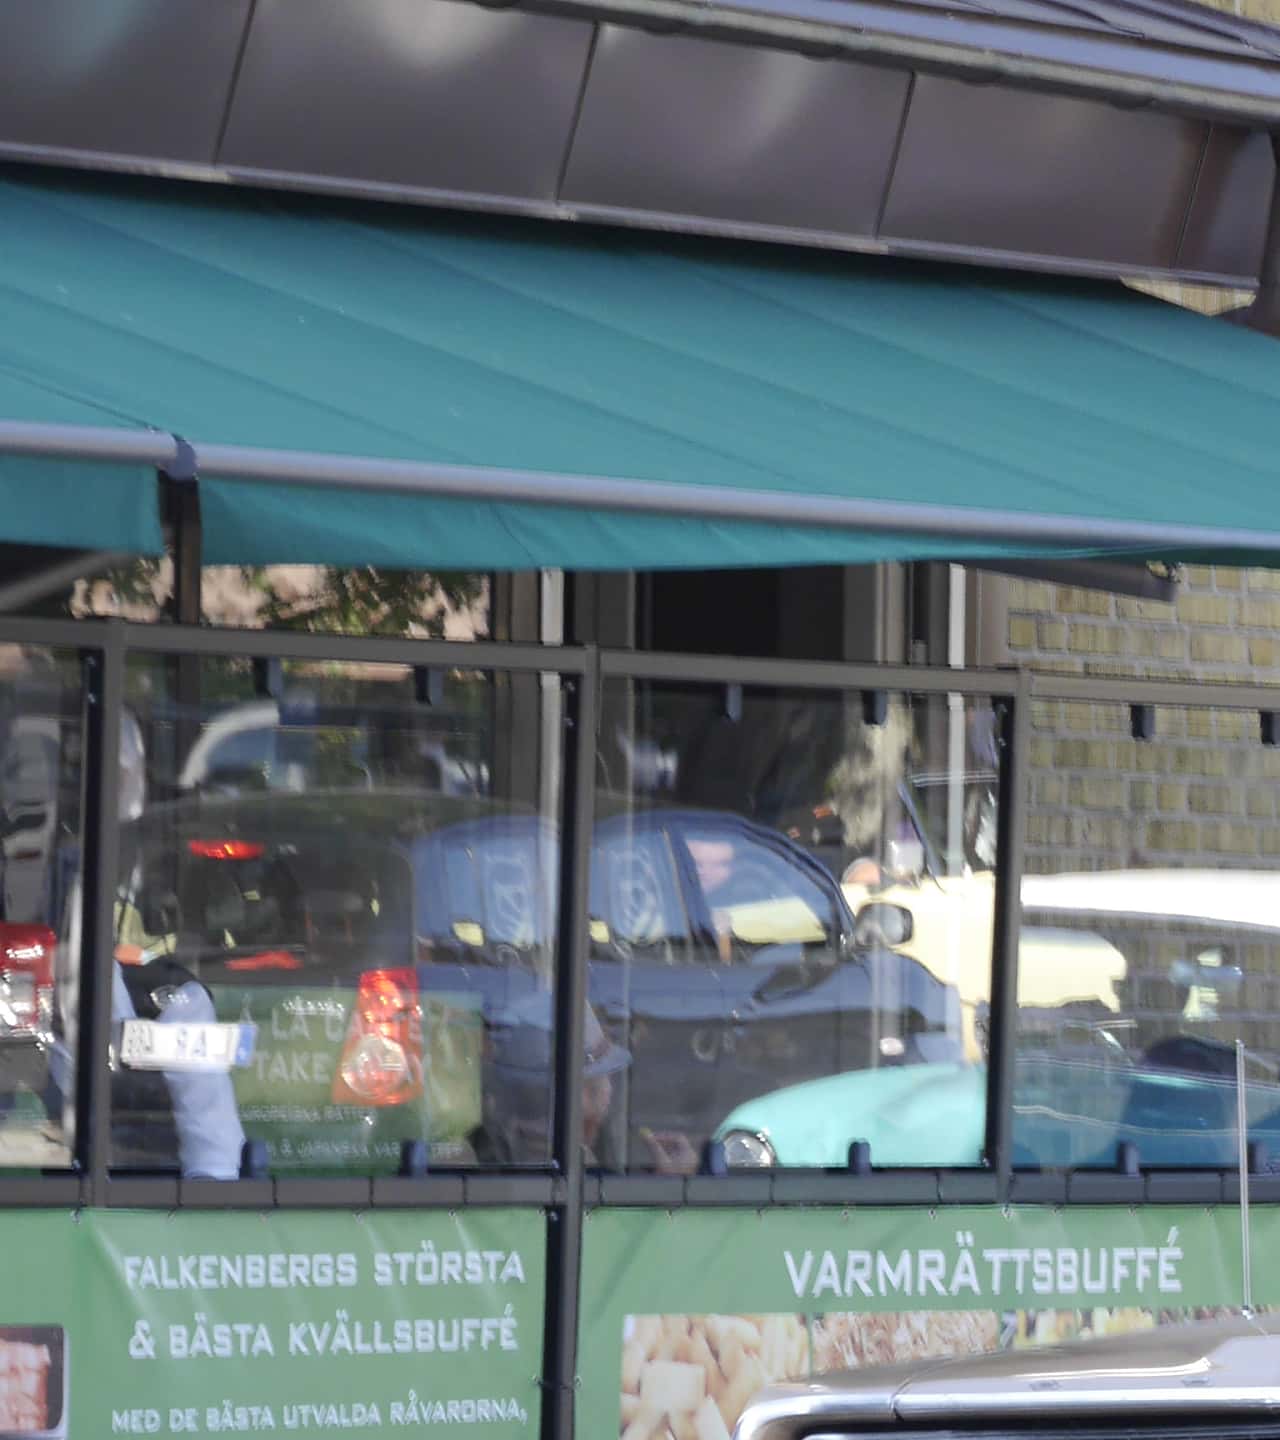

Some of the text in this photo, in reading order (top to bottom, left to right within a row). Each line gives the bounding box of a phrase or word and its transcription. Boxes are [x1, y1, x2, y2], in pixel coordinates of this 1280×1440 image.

[254, 1053, 331, 1083] TAKE
[124, 1240, 525, 1289] FALKENBERGS STÖRSTA
[783, 1225, 1184, 1298] VARMRÄTTSBUFFÉ
[129, 1303, 518, 1359] & BÄSTA KVÄLLSBUFFÉ
[111, 1408, 160, 1434] MED
[169, 1408, 199, 1433] DE
[206, 1399, 275, 1432] BÄSTA
[283, 1402, 381, 1429] UTVALDA
